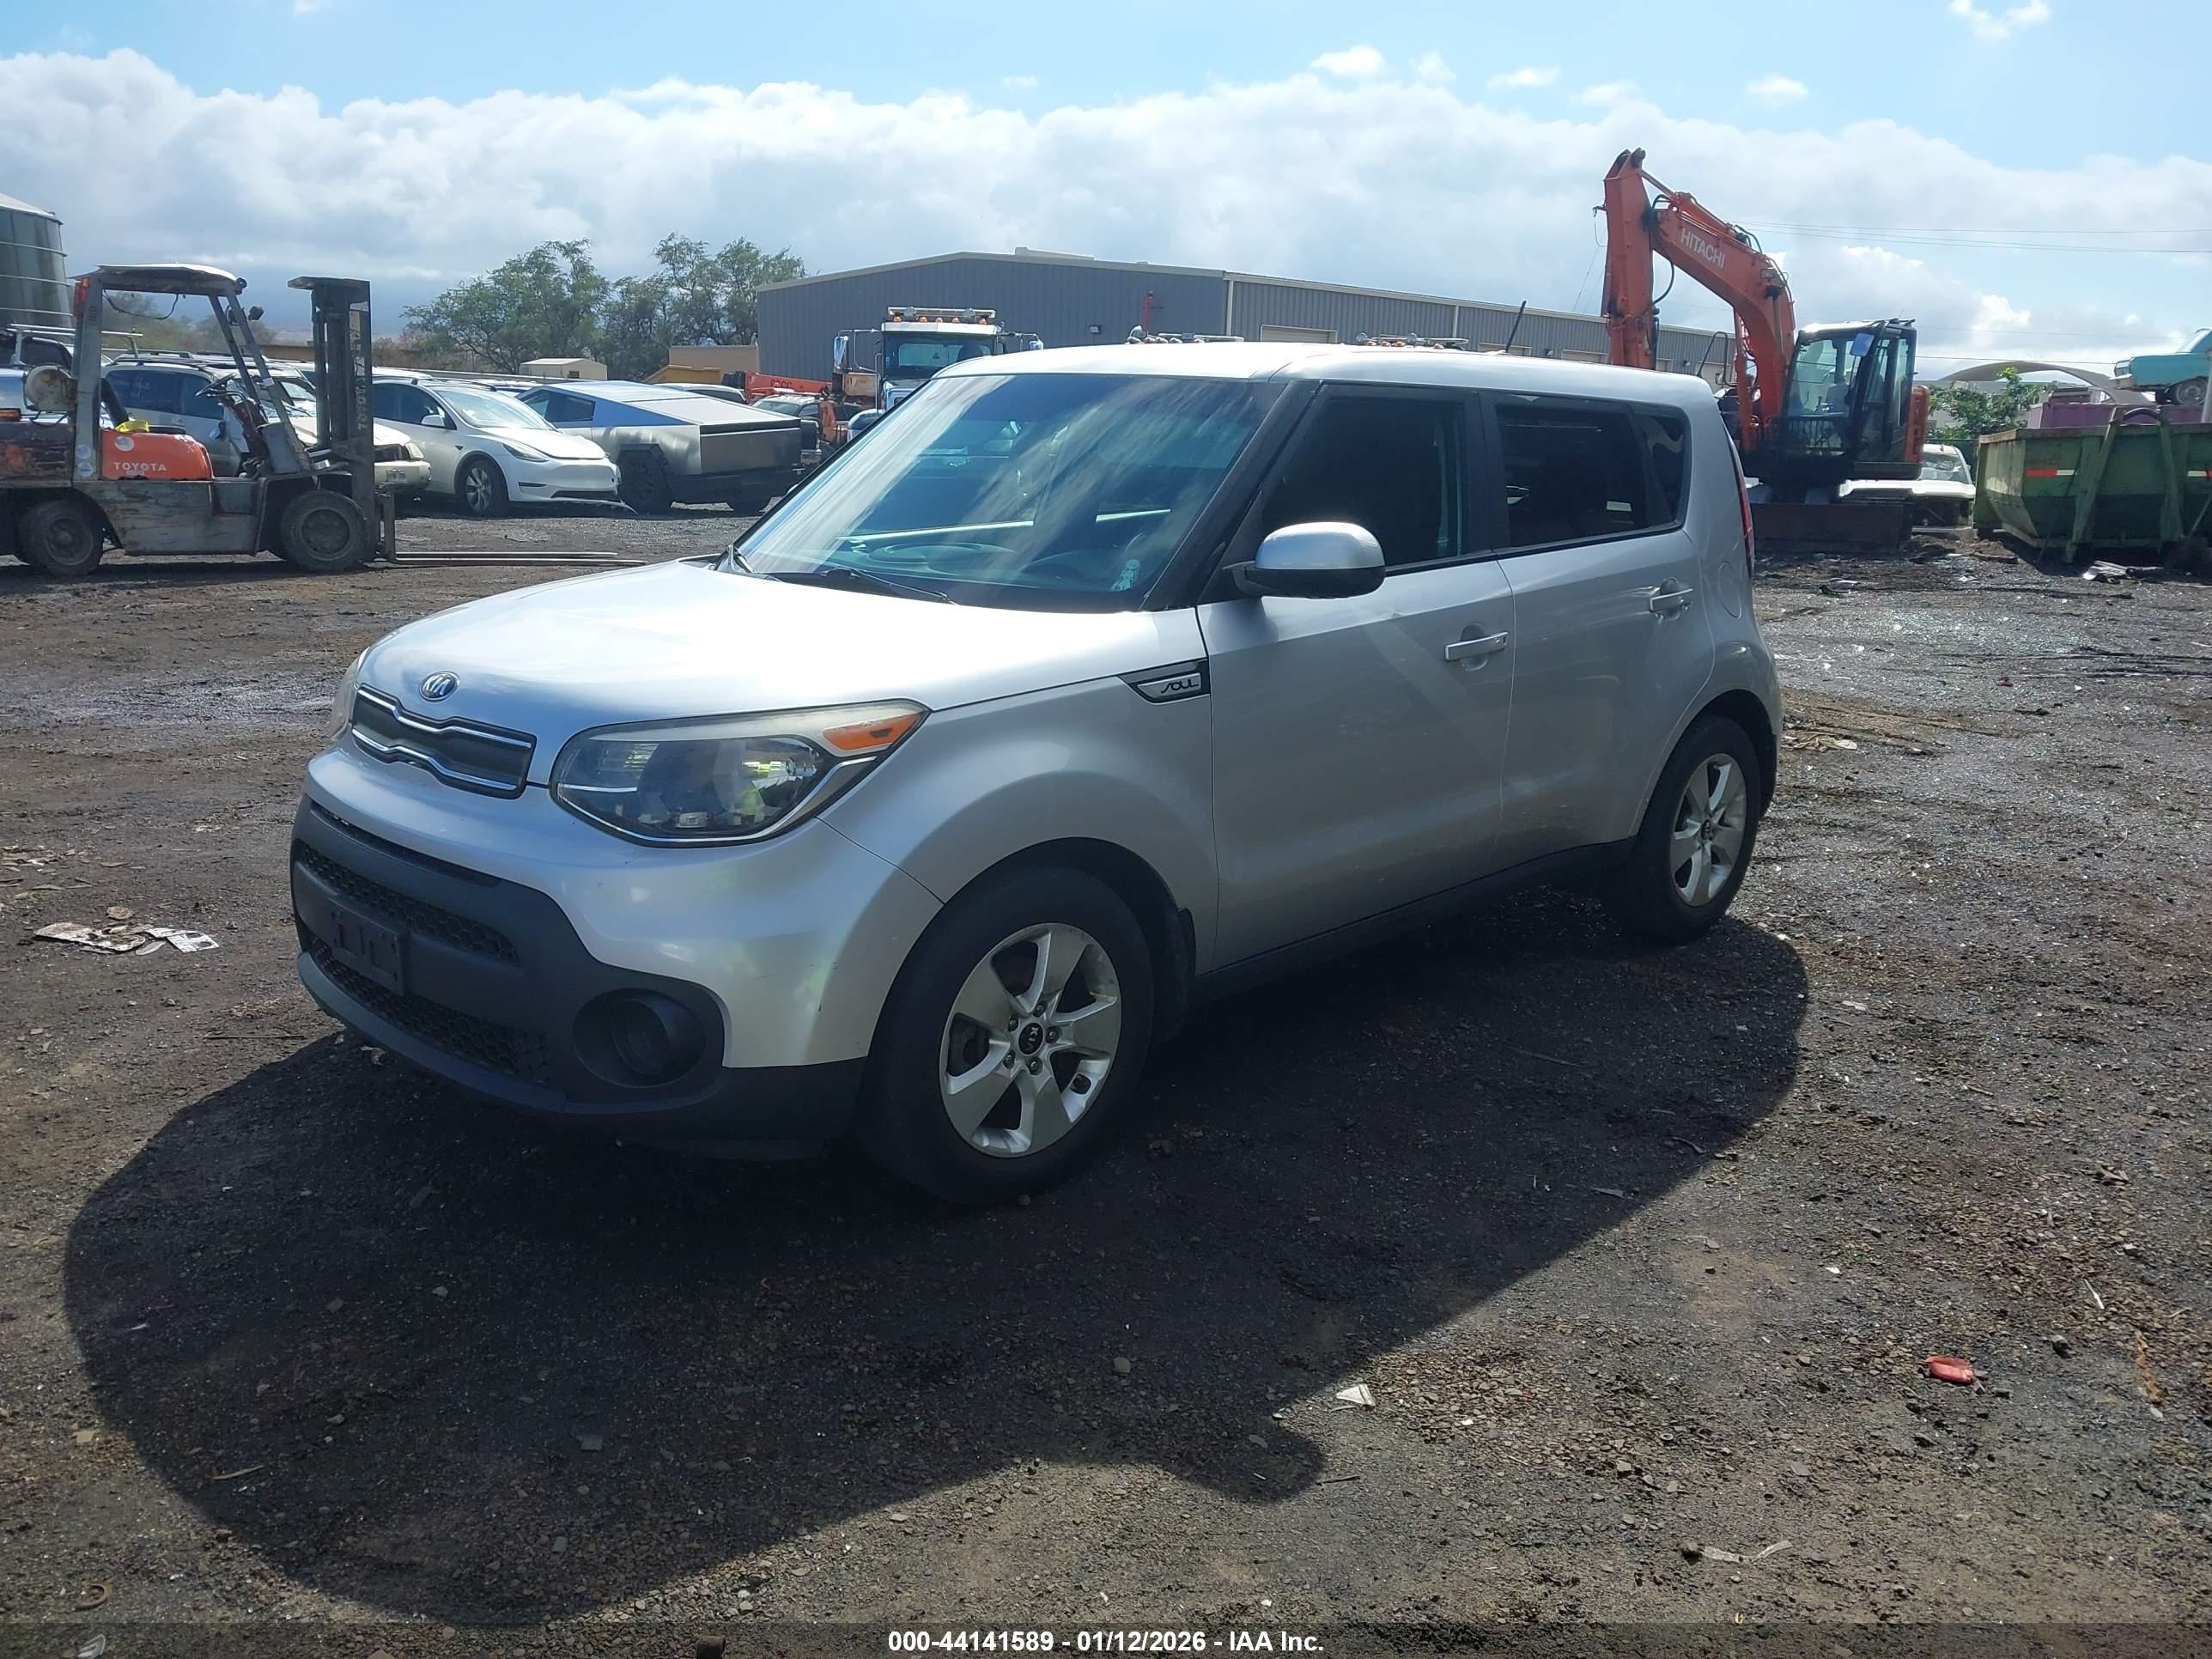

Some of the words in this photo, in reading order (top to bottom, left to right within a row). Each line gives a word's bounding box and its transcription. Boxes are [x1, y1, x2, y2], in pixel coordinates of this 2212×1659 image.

[1681, 228, 1725, 268] HITACHI
[113, 462, 167, 471] TOYOTA
[422, 675, 451, 696] KIA
[1160, 679, 1200, 694] SOUL
